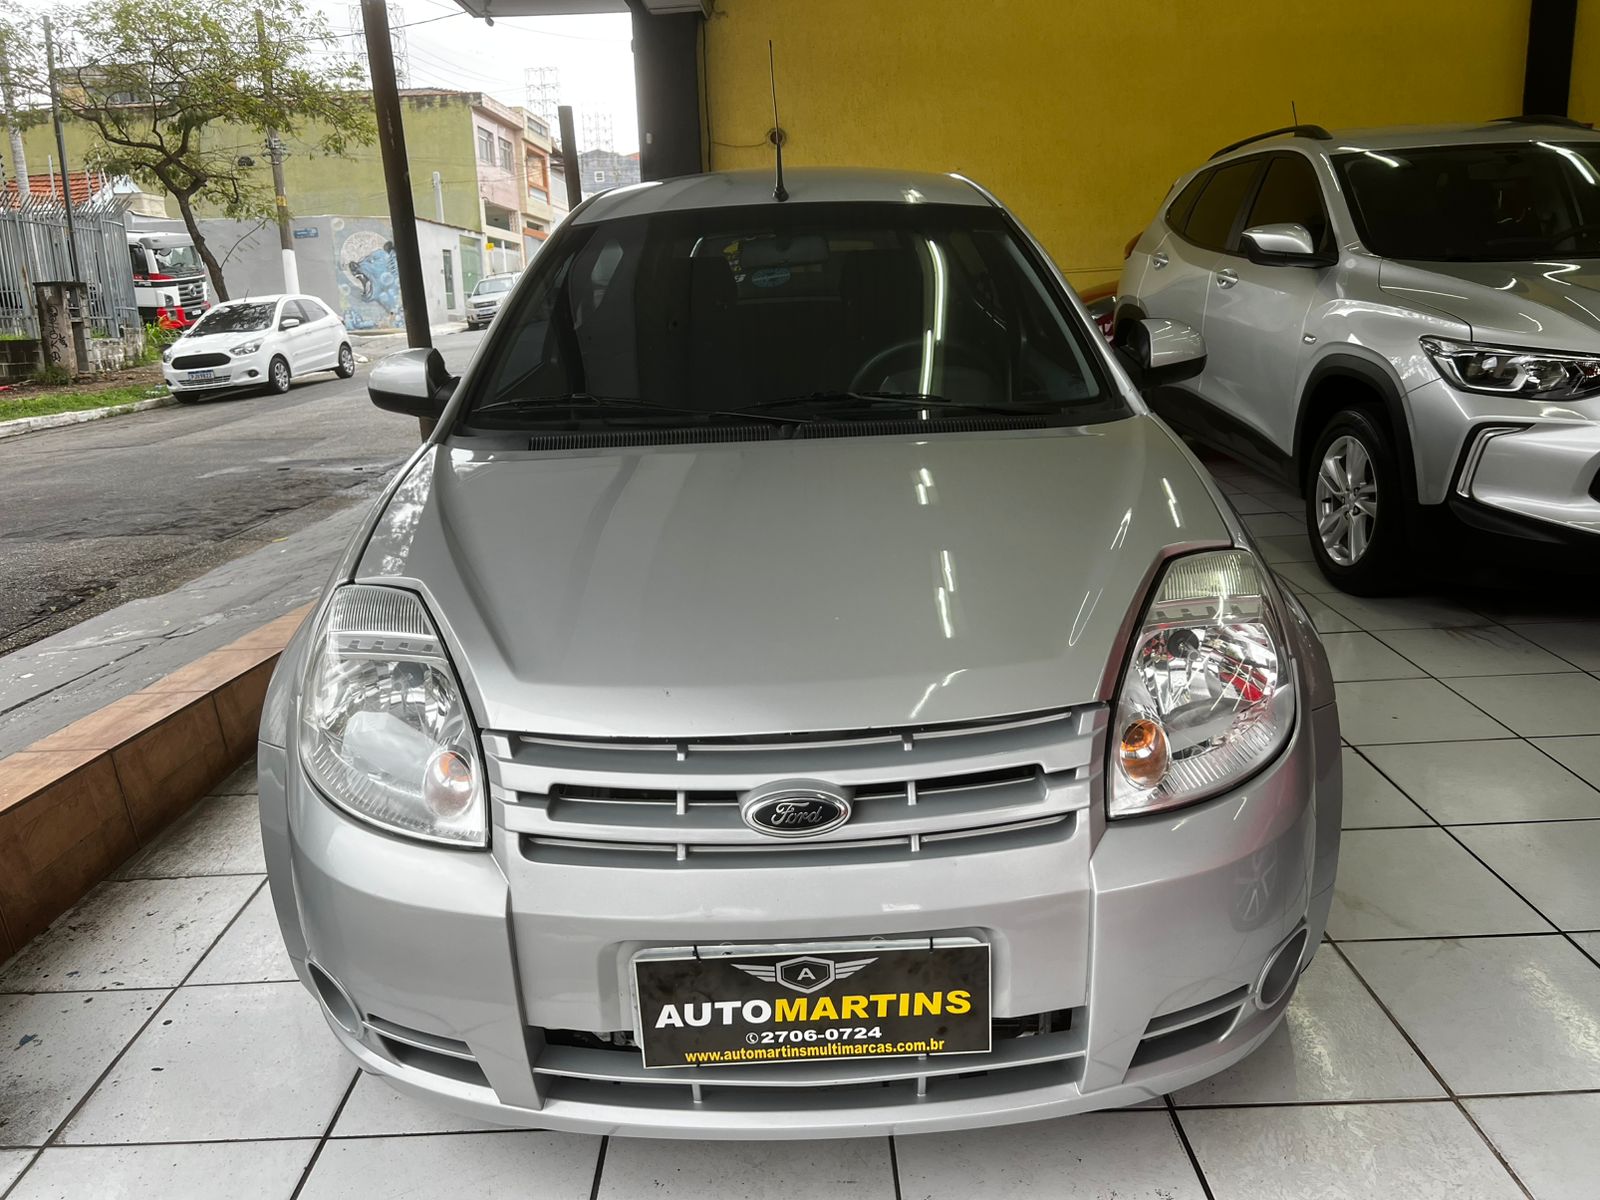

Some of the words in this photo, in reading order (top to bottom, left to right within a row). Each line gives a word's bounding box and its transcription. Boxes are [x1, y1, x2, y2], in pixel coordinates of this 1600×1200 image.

[770, 801, 823, 826] Ford
[796, 967, 817, 981] A
[654, 990, 972, 1029] AUTOMARTINS
[760, 1026, 883, 1043] 2706-0724
[684, 1038, 945, 1062] www.automartinsmultimarcas.com.br
